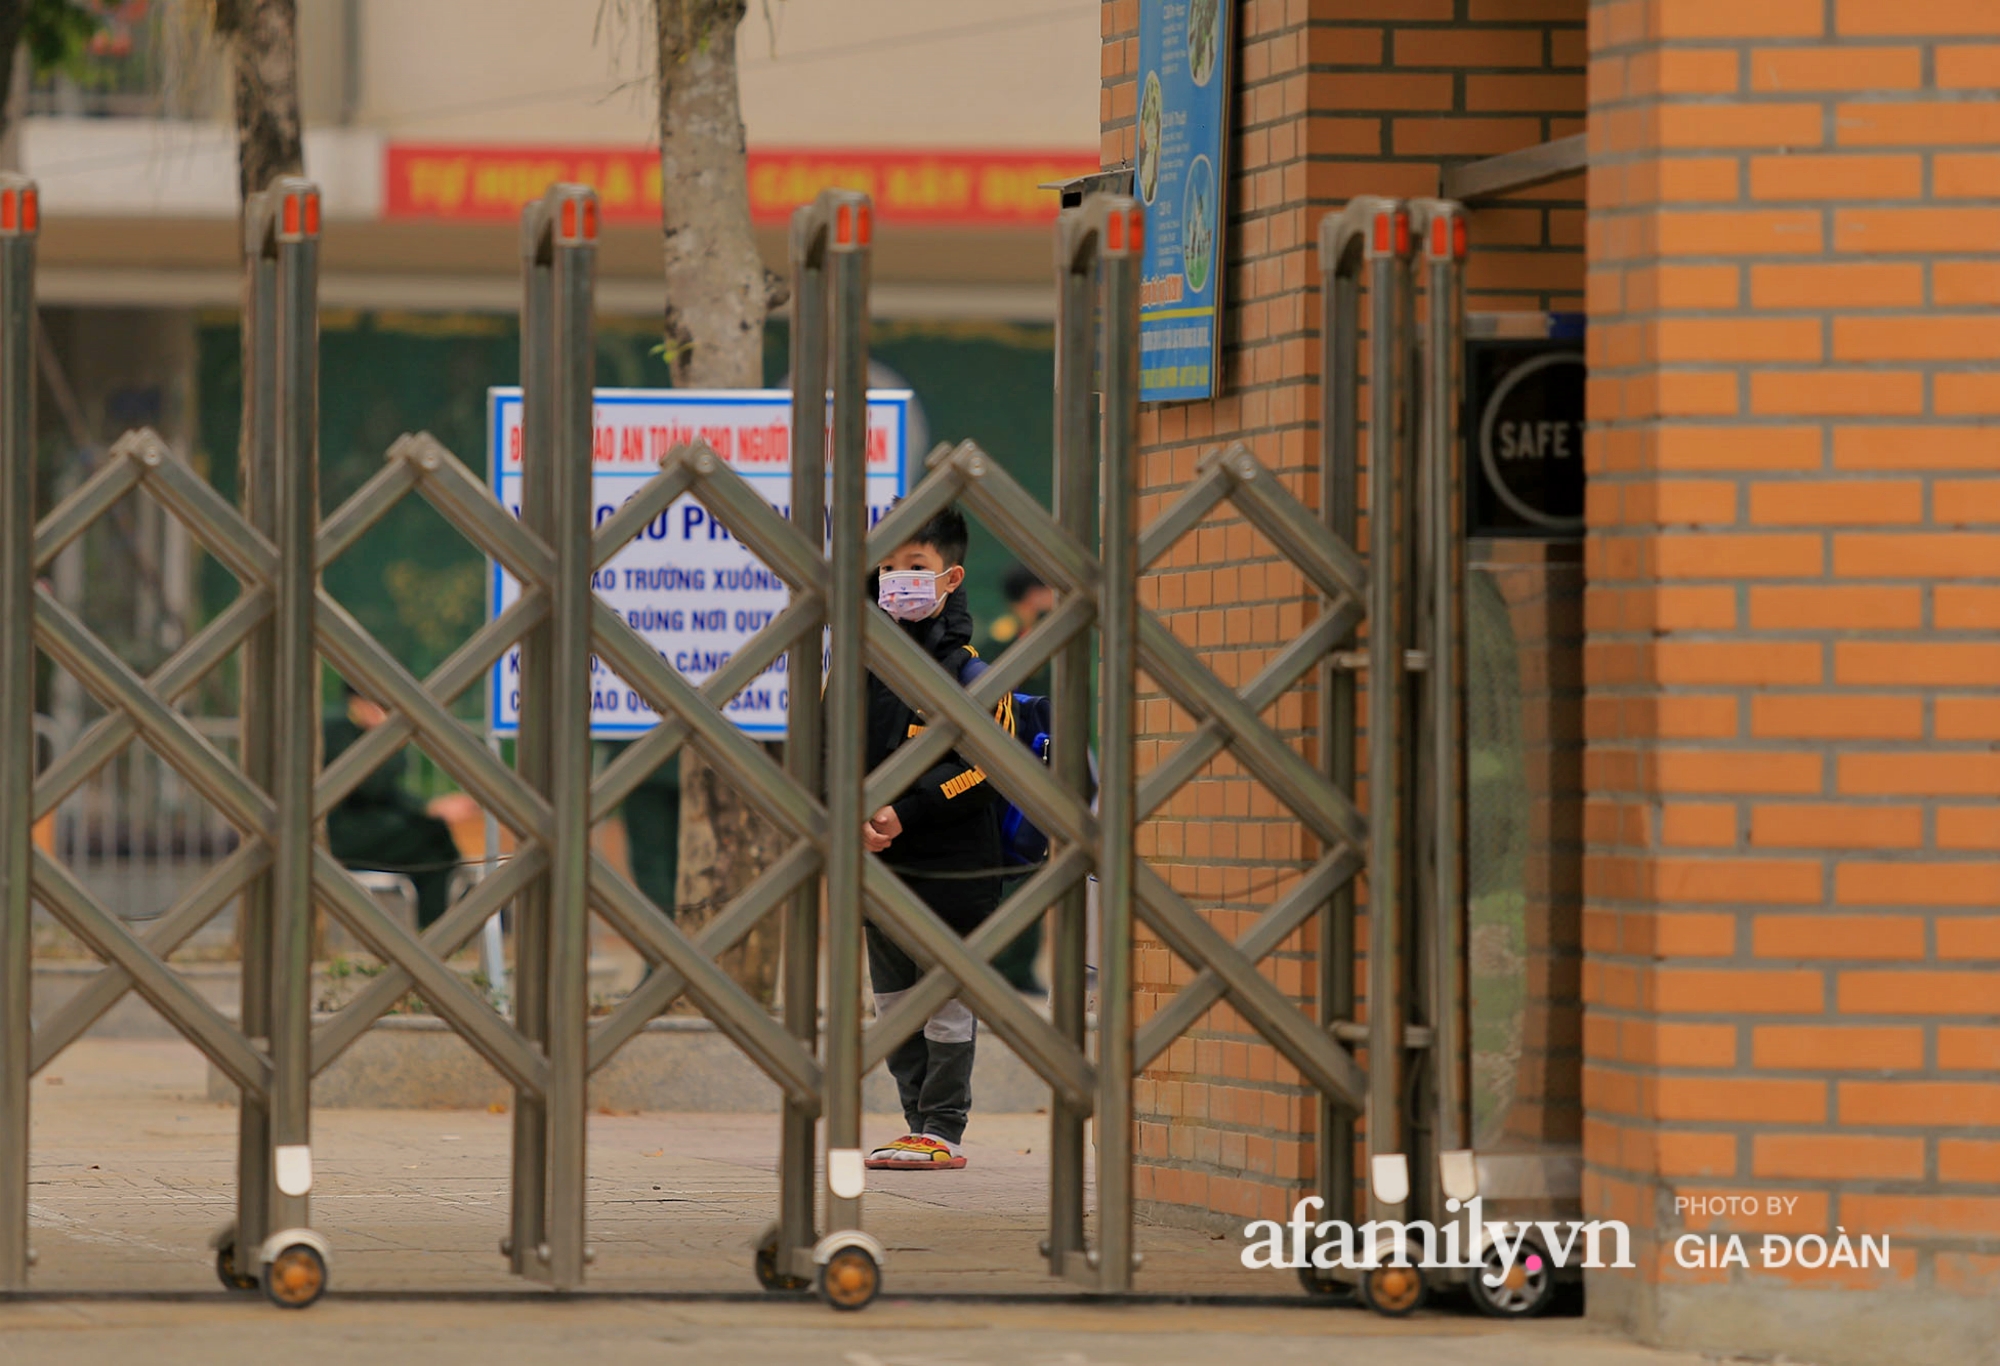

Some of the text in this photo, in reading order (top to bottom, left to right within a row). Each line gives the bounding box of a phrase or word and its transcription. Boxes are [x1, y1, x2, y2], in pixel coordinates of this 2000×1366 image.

[620, 426, 644, 462] AN
[1501, 421, 1571, 459] SAFE
[624, 562, 705, 591] TRƯỜNG
[691, 609, 727, 632] NƠI
